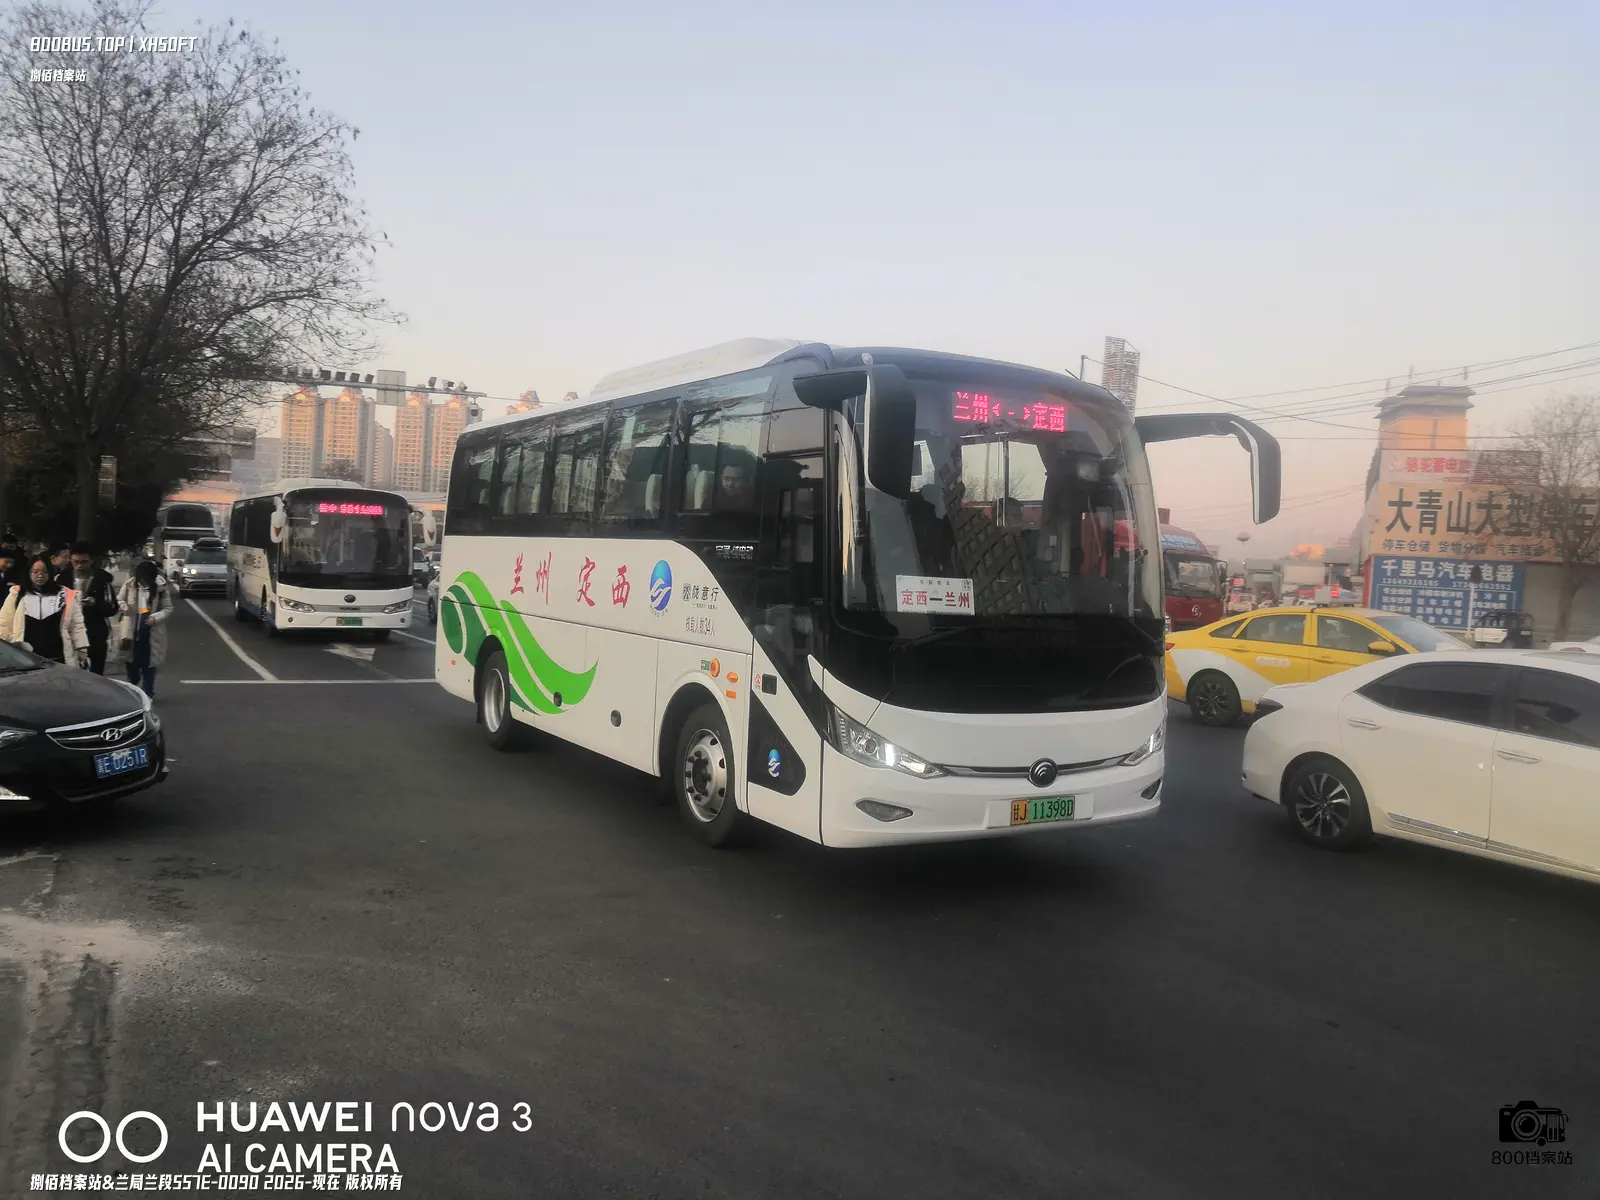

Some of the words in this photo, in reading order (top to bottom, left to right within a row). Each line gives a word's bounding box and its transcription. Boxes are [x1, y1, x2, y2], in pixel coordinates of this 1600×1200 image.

[510, 551, 552, 606] 兰州
[576, 556, 632, 609] 定西
[1381, 559, 1514, 582] 千里马汽车电器
[1012, 799, 1074, 822] 甘J11398D
